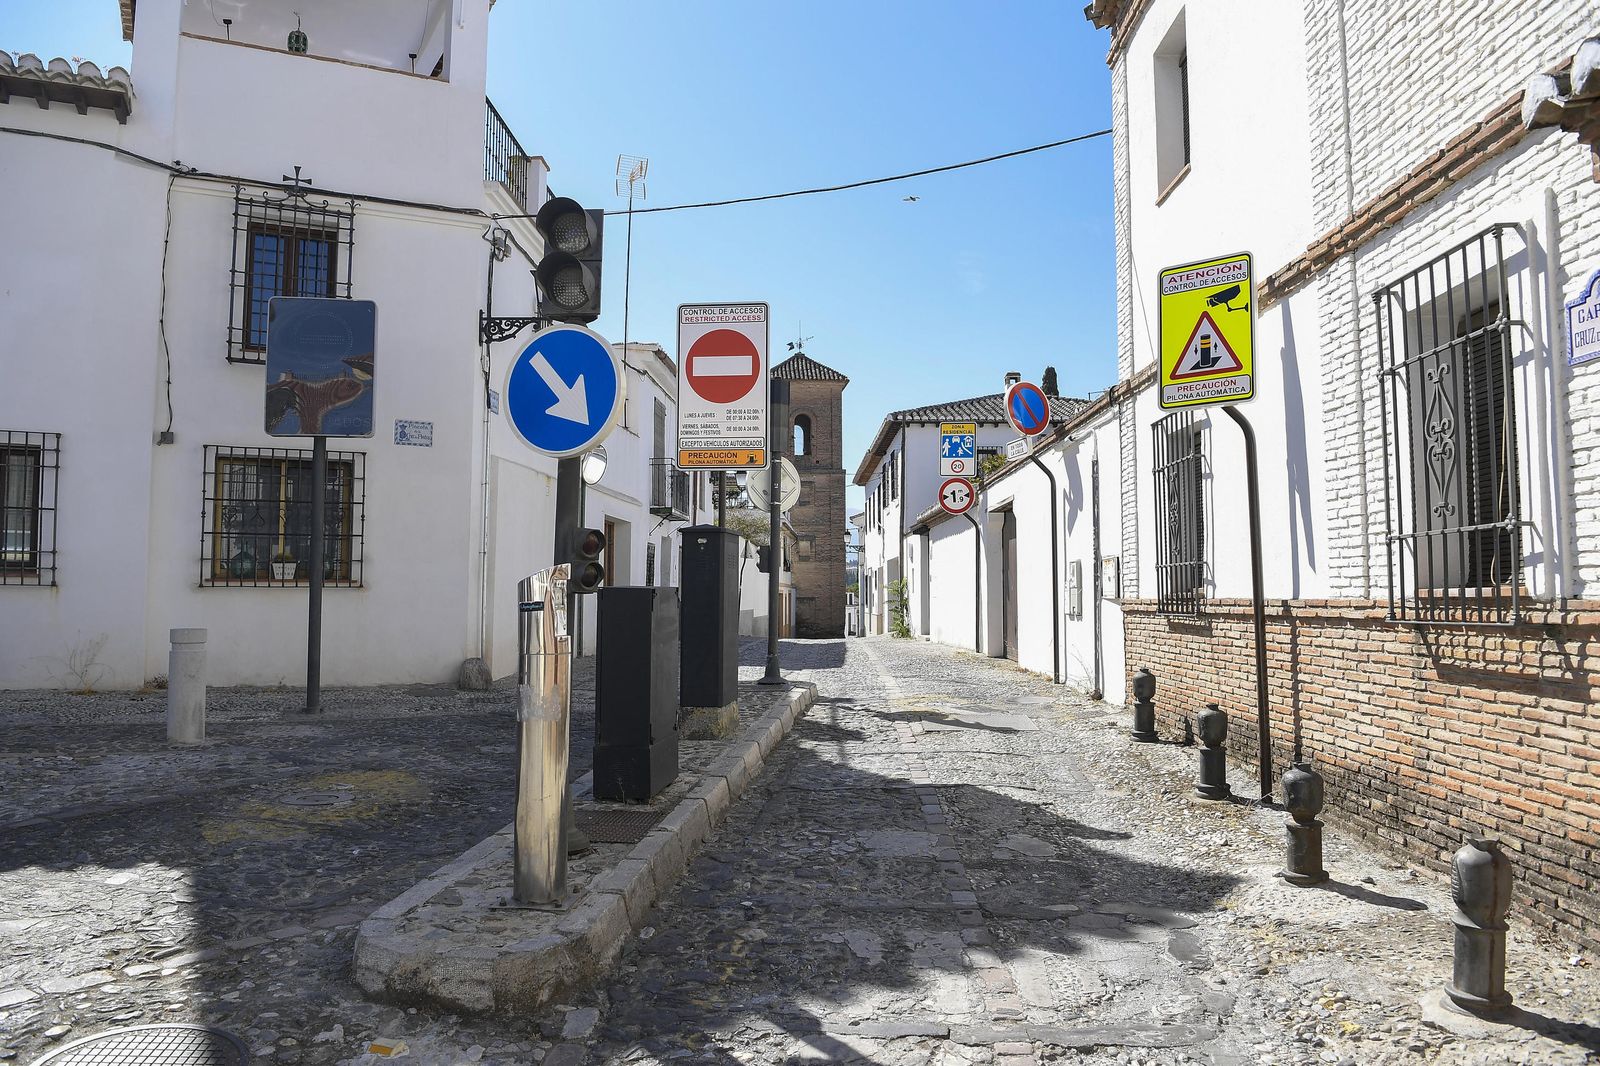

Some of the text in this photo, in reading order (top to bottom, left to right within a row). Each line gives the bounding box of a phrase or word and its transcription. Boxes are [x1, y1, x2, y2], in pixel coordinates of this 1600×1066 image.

[1164, 282, 1198, 293] CONTROL
[1211, 272, 1247, 284] ACCESOS
[1168, 264, 1242, 284] ATENCIÓN
[1574, 327, 1596, 348] CRUZ
[1166, 386, 1246, 401] PILONA AUTOMÁTICA
[1177, 379, 1237, 392] PRECAUCIÓN
